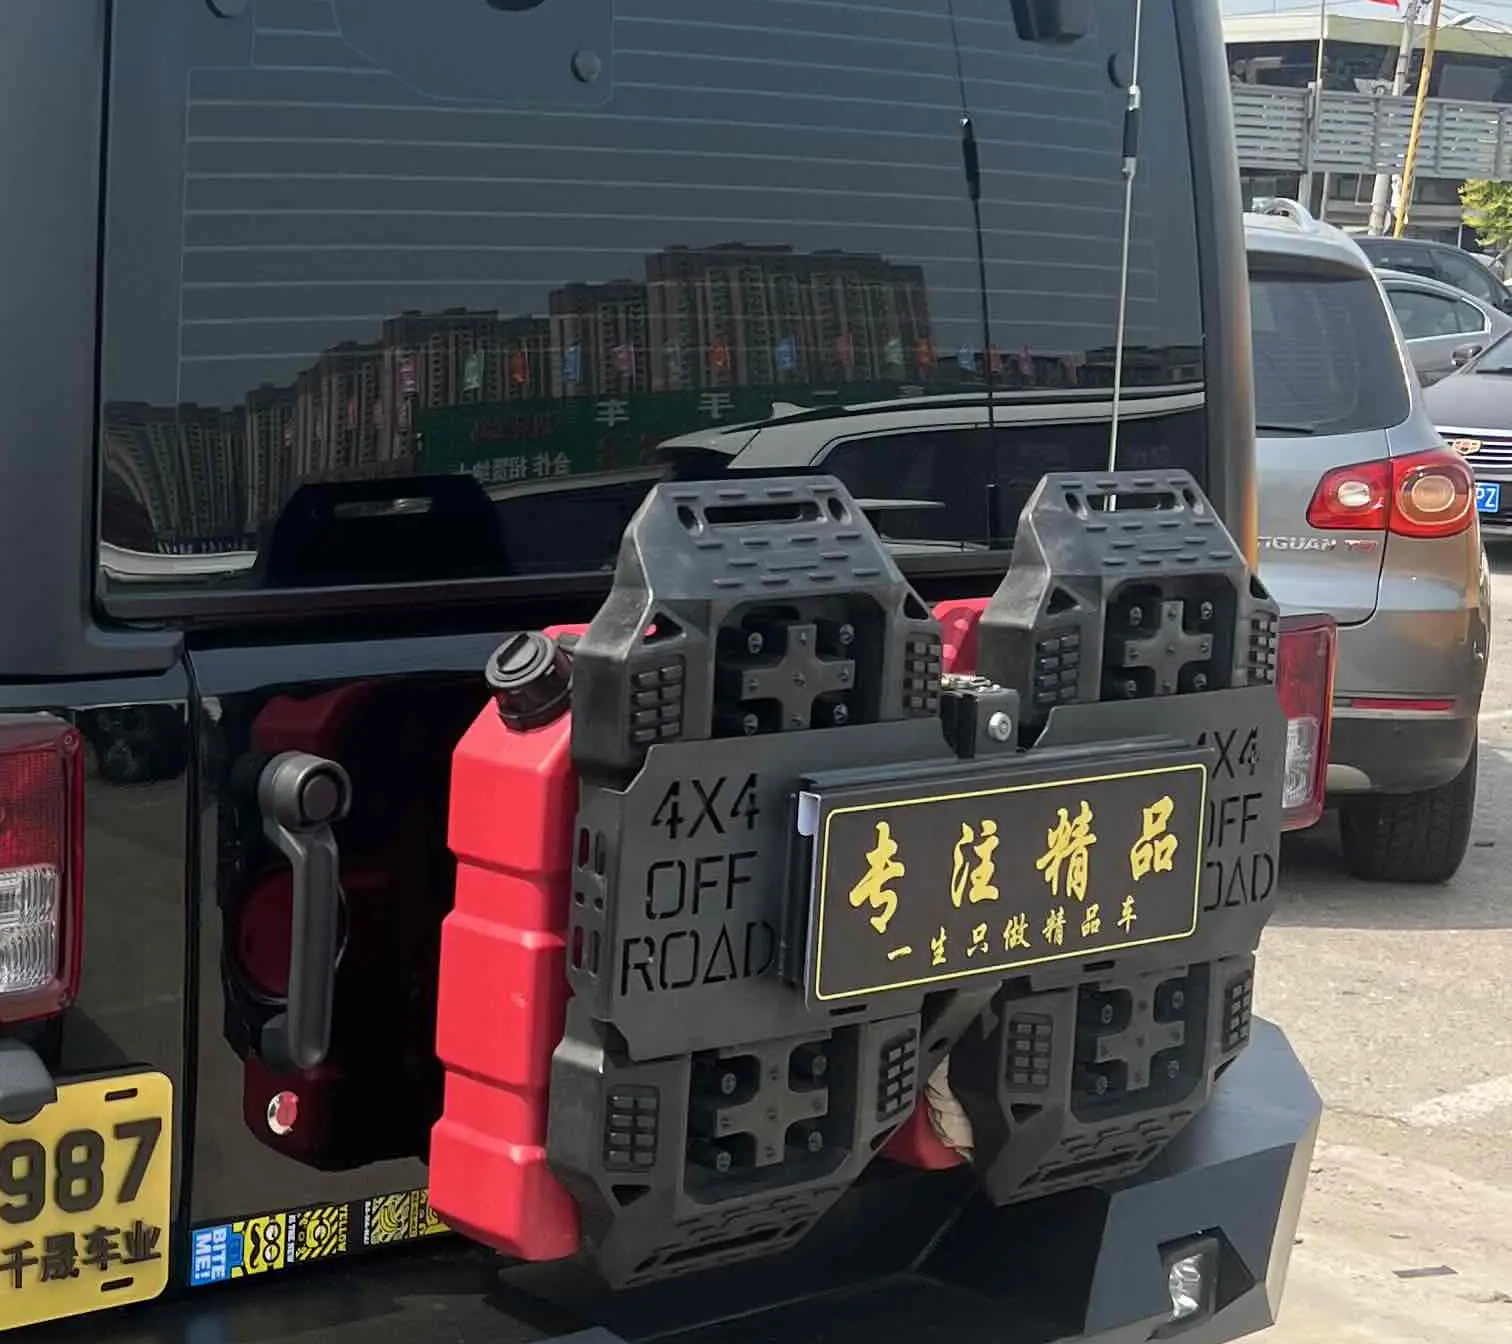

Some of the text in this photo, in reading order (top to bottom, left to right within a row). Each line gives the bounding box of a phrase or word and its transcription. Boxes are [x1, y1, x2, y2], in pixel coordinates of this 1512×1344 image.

[1196, 725, 1260, 780] X4
[650, 772, 761, 840] 4X4
[645, 850, 759, 921] OFF
[849, 795, 1179, 935] 专注精品
[1203, 852, 1274, 913] OAD
[620, 920, 777, 997] ROAD
[887, 895, 1138, 966] 一生只做精品车
[194, 1231, 212, 1281] ME!
[210, 1227, 227, 1281] BITE
[338, 1203, 349, 1253] YELLOW
